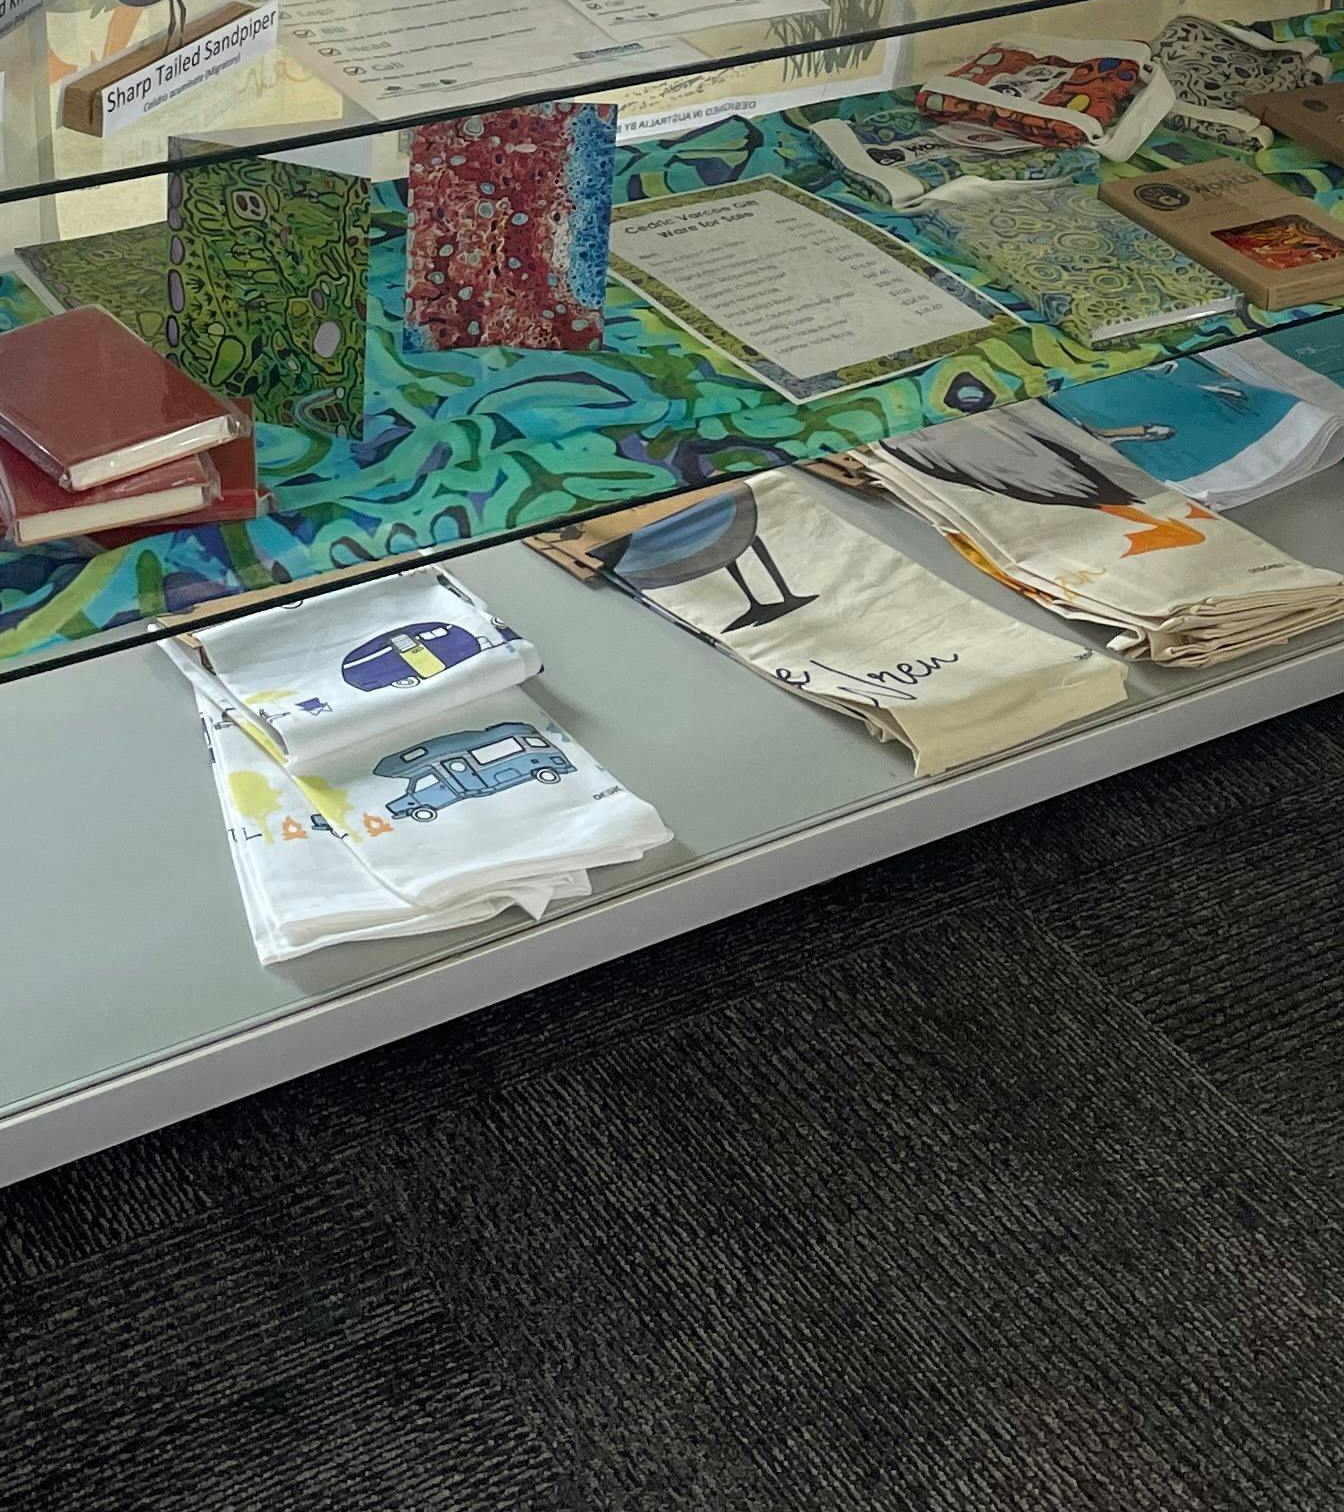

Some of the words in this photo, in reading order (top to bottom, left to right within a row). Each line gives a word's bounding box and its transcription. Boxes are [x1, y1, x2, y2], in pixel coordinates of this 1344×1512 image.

[106, 70, 153, 115] Sharp
[155, 51, 201, 93] Tailed
[201, 6, 278, 72] Sandpiper
[624, 218, 674, 235] Cedric
[675, 206, 732, 222] Varcoe
[657, 225, 698, 238] Ware
[699, 217, 720, 230] for
